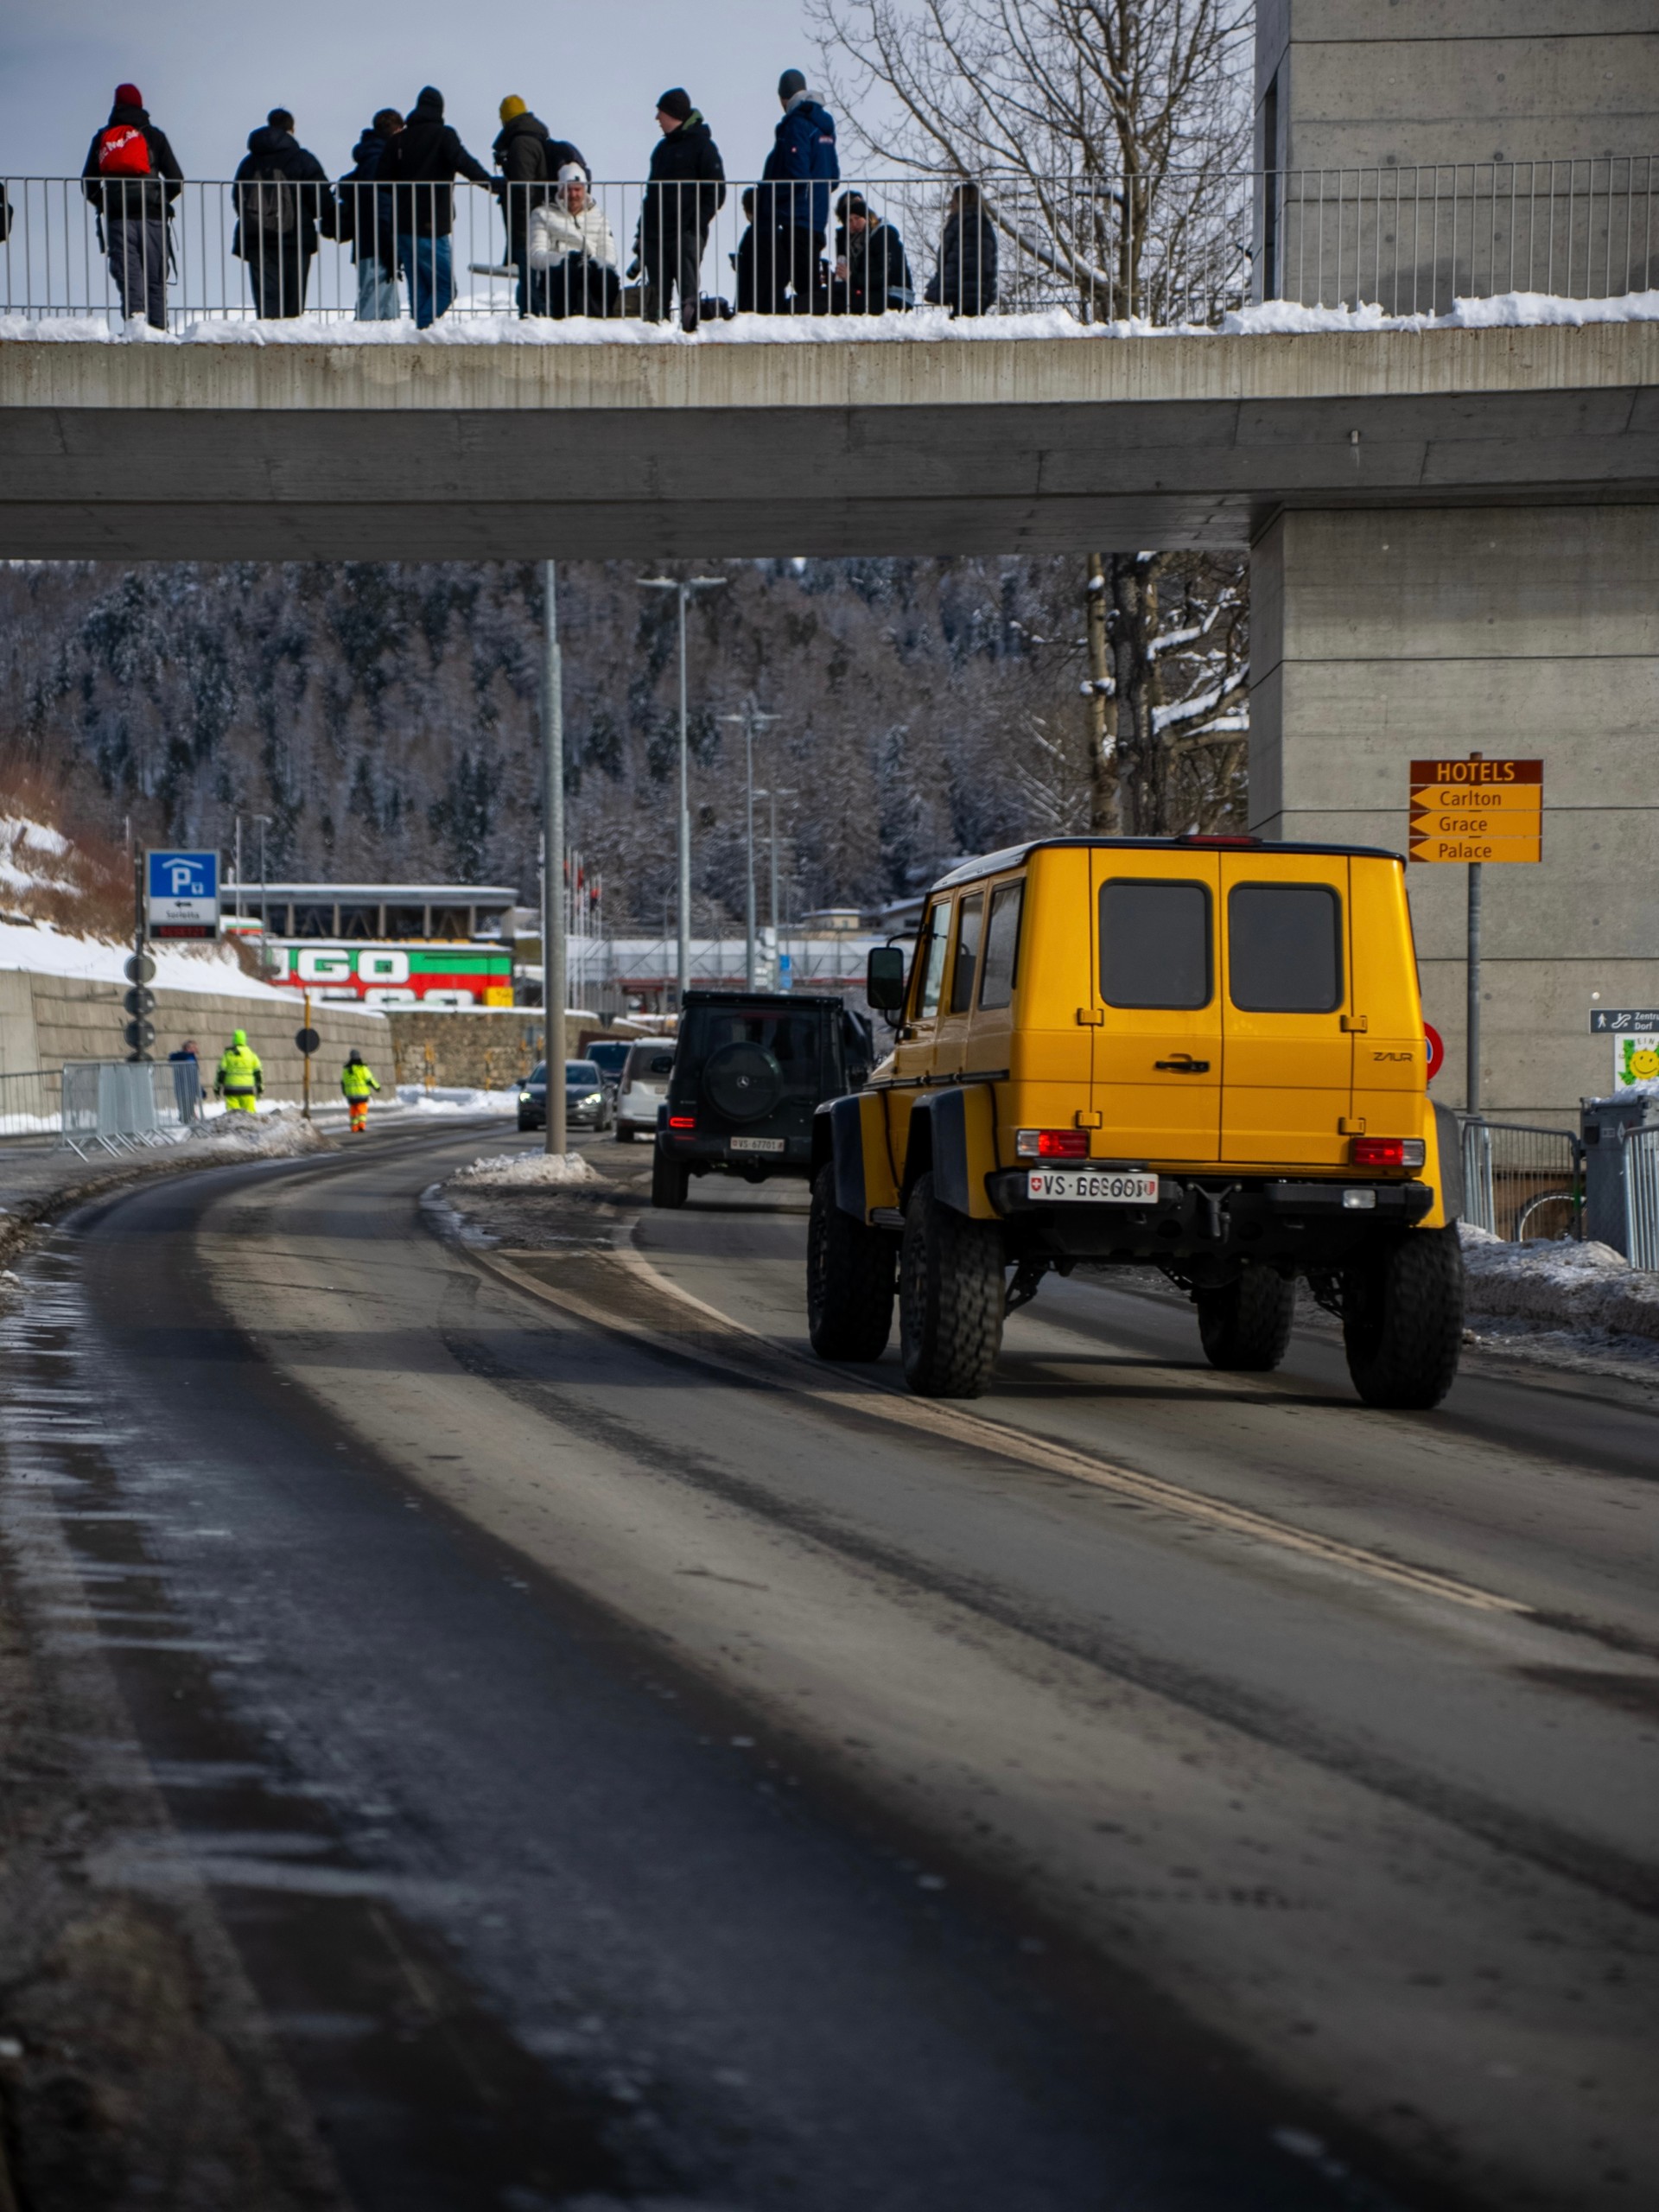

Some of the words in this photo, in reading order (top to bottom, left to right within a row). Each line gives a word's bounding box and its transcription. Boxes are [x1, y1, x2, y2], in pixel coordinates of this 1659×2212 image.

[1437, 762, 1516, 782] HOTELS
[1440, 790, 1502, 806] Carlton
[1439, 817, 1488, 832] Grace
[1439, 842, 1492, 858] Palace
[1635, 1022, 1652, 1031] Dorf
